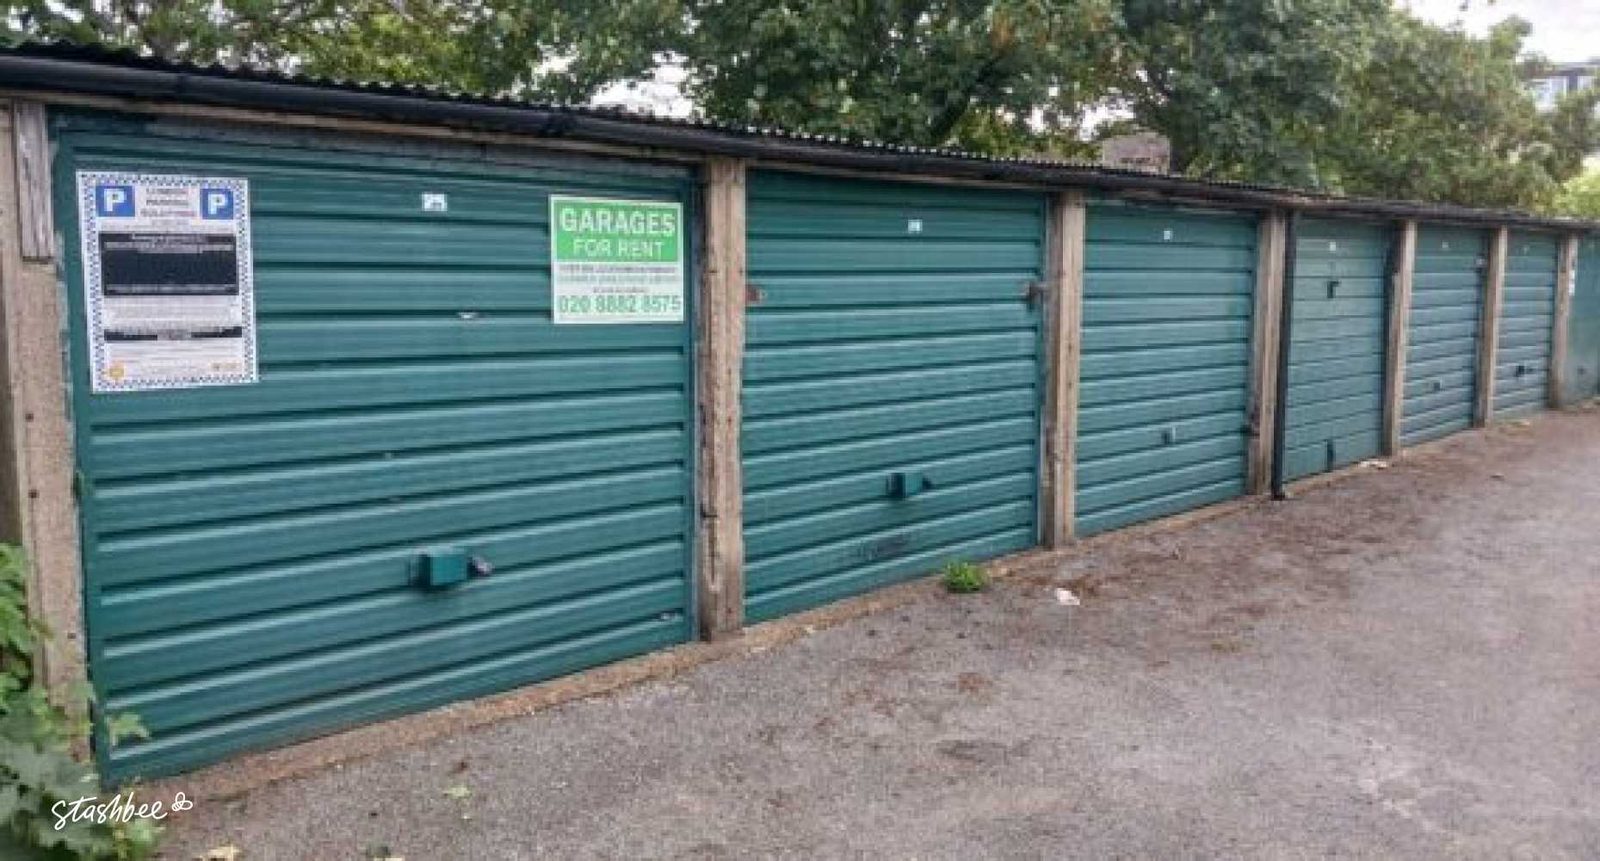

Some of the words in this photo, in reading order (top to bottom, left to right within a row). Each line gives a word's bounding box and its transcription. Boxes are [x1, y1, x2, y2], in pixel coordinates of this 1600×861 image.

[103, 189, 127, 213] P
[207, 193, 228, 215] P
[560, 207, 676, 237] GARAGES
[572, 239, 612, 257] FOR
[618, 241, 664, 257] RENT
[559, 294, 591, 314] 020
